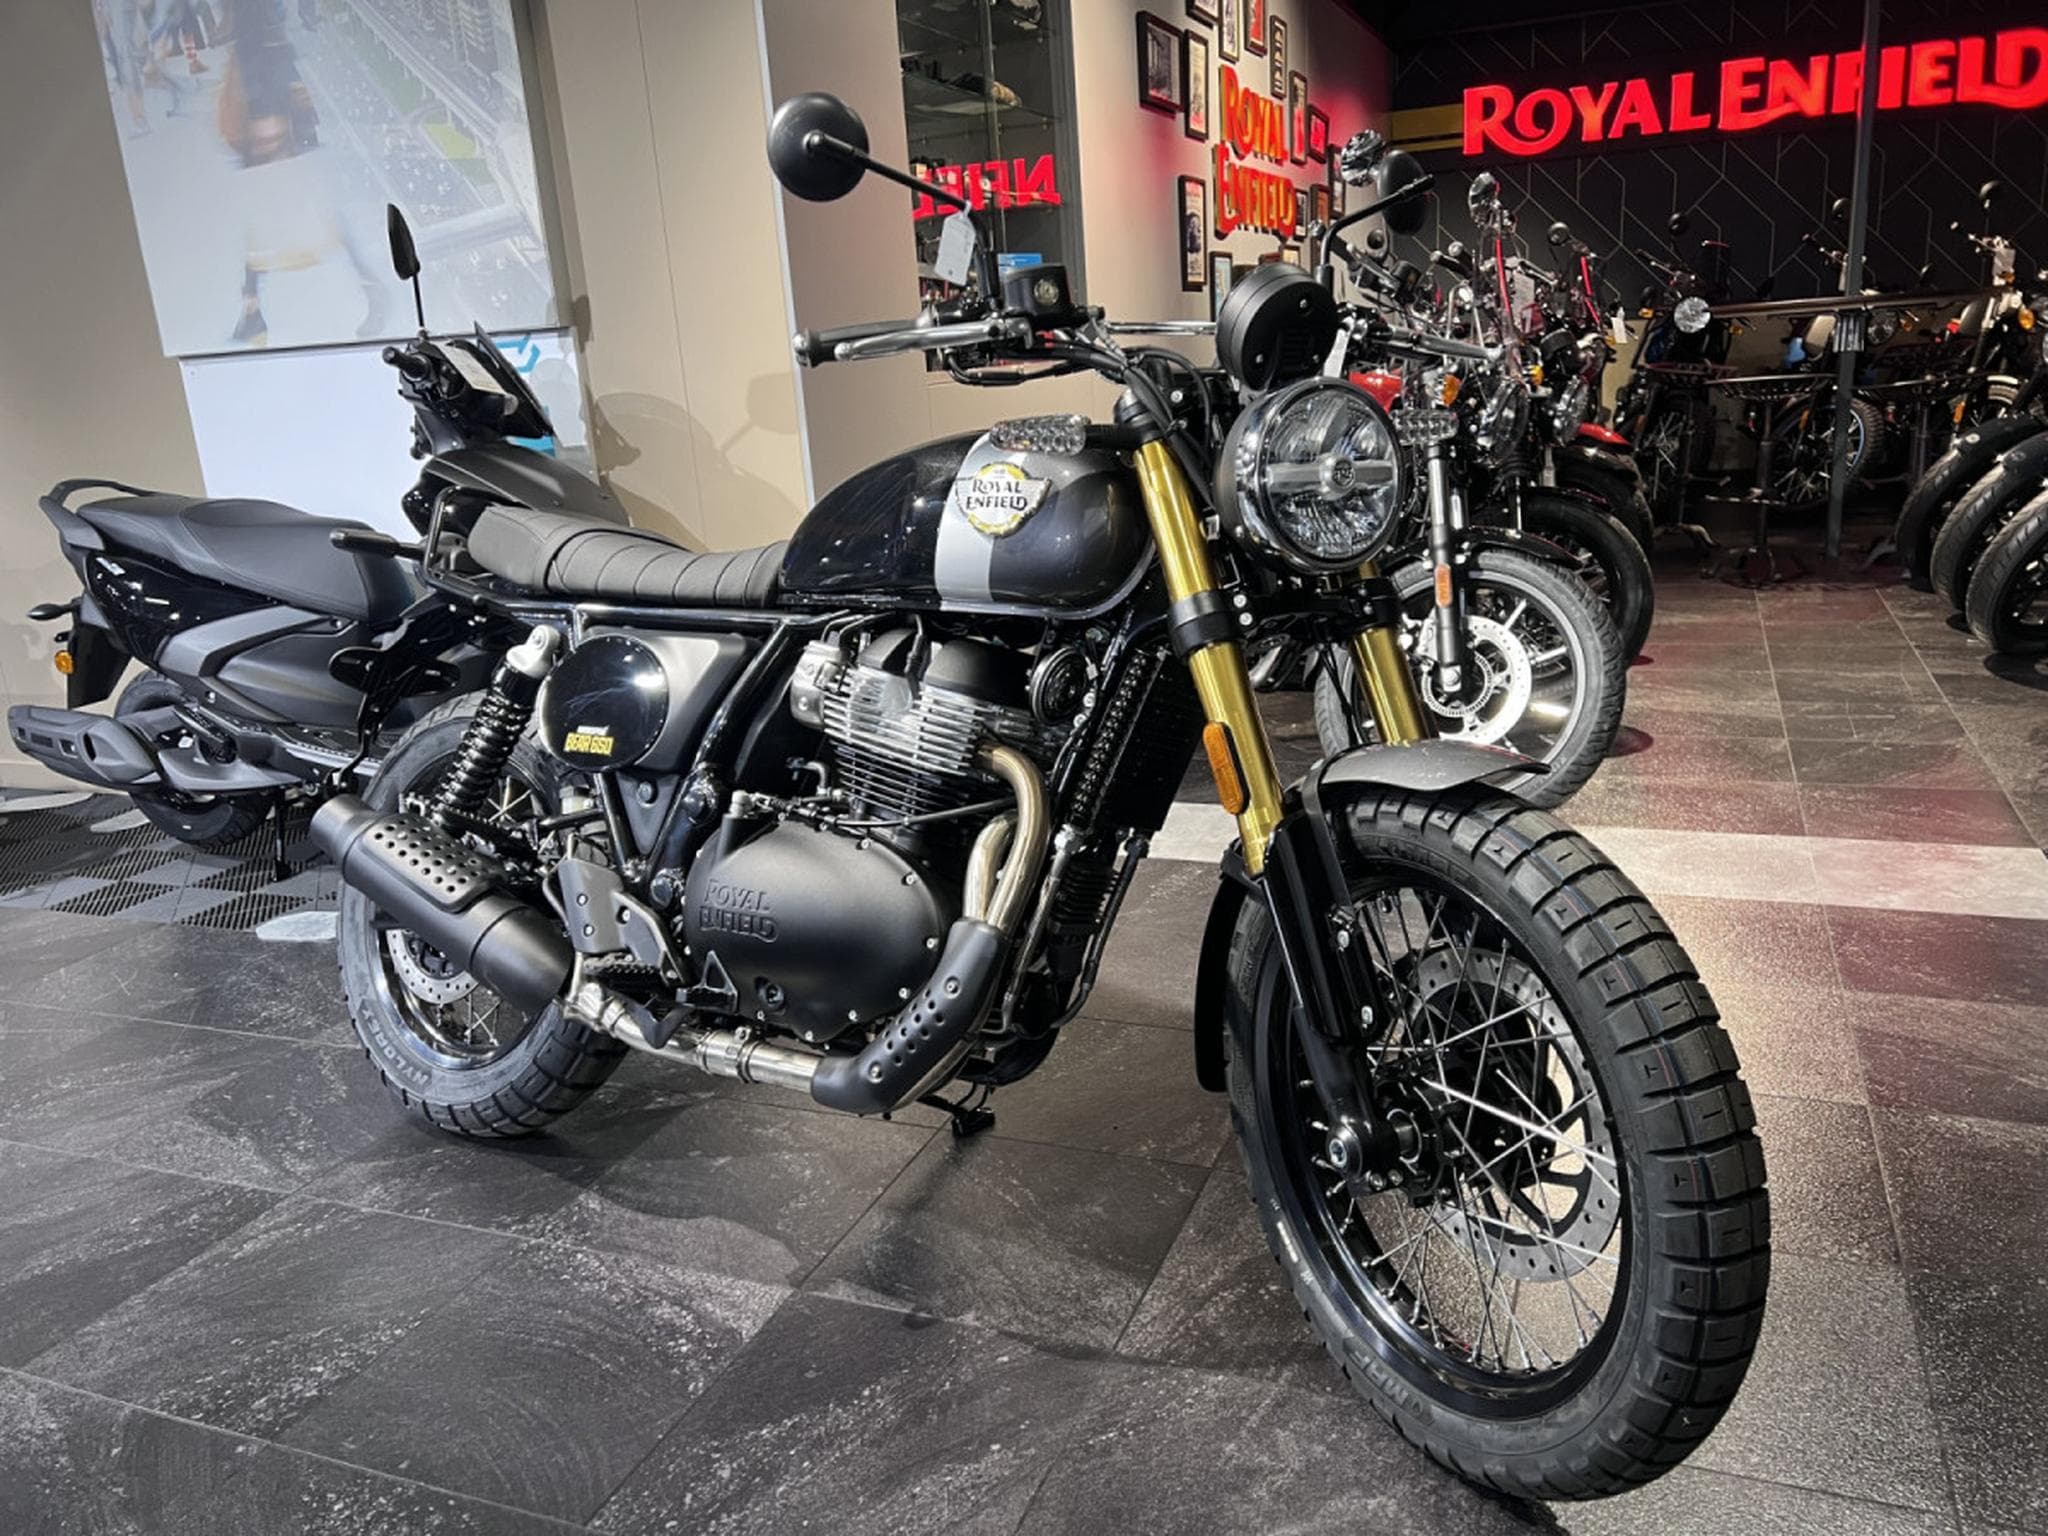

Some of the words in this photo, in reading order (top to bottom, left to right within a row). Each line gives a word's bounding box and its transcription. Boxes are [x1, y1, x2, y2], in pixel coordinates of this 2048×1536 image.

[1219, 64, 1288, 165] ROYAL
[1463, 71, 1711, 157] ROYAL
[1213, 142, 1296, 240] ENFIELD
[966, 495, 1028, 511] ENFIELD
[972, 479, 1023, 494] ROYAL
[704, 878, 771, 914] ROYAL
[699, 905, 780, 943] ENFIELD
